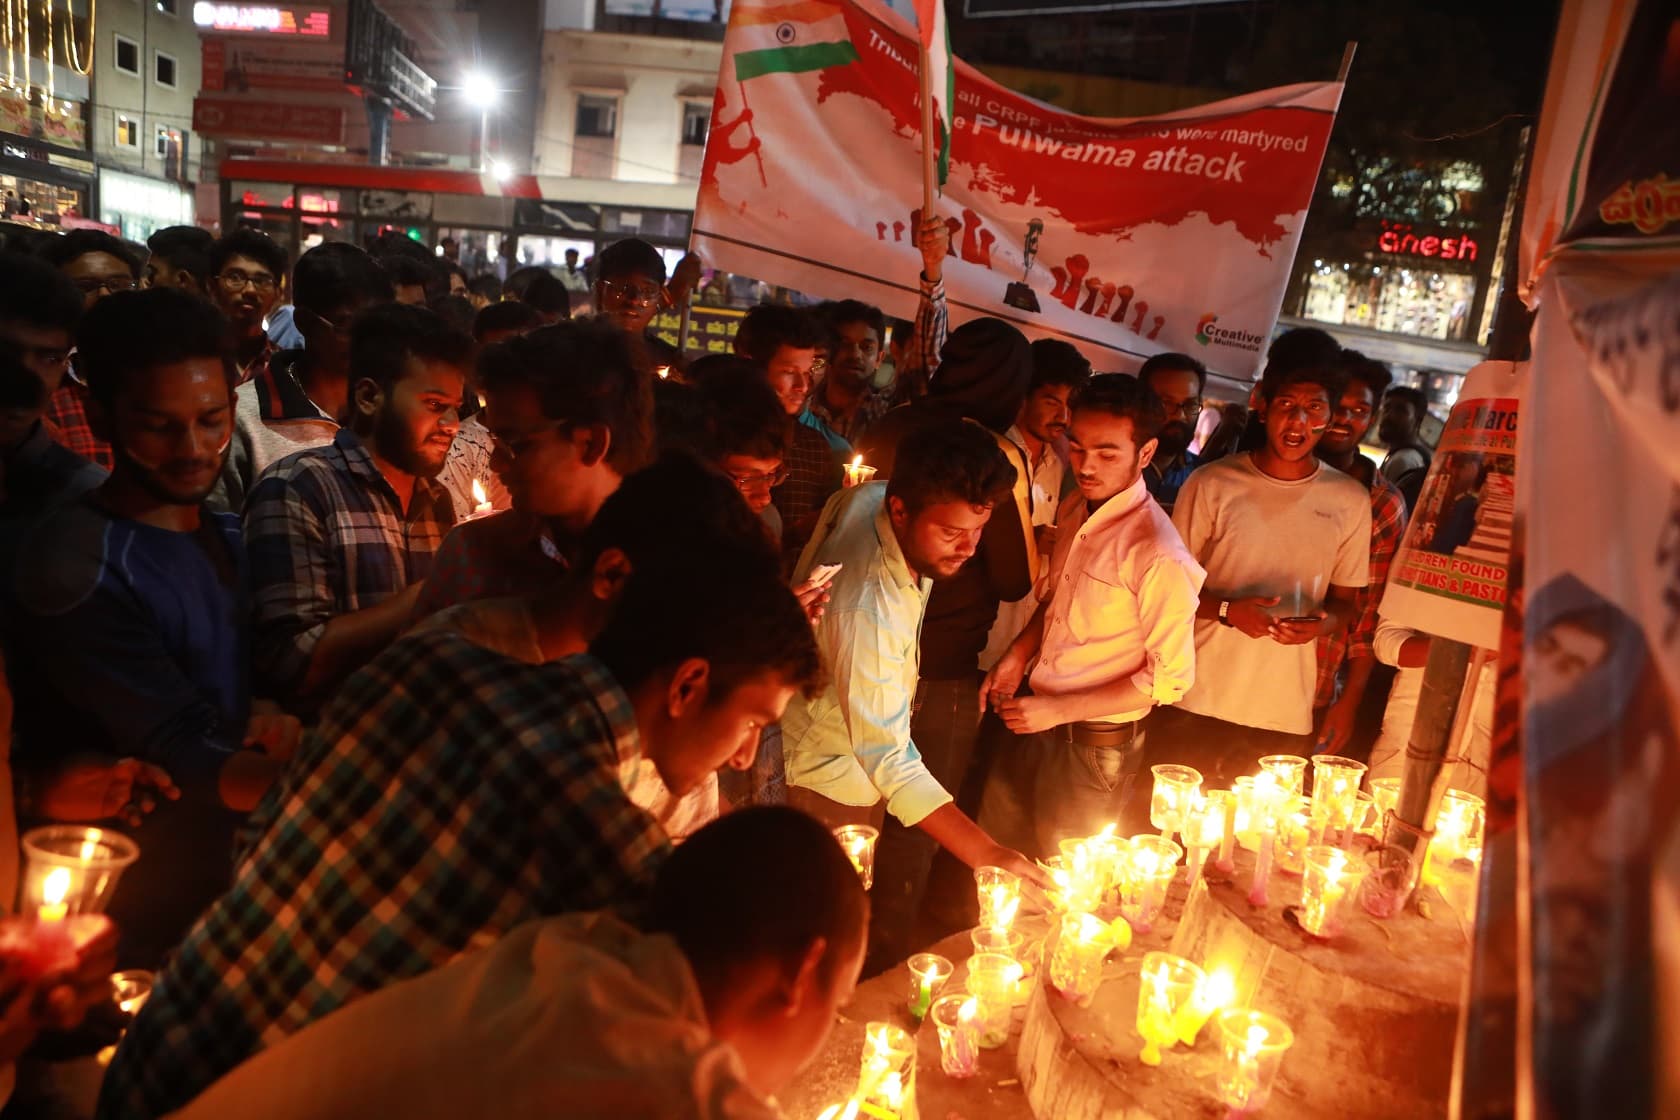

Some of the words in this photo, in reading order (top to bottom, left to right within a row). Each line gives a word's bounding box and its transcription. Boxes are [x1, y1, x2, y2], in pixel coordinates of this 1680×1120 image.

[958, 90, 981, 107] all
[986, 101, 1041, 128] CRPF
[1220, 129, 1308, 152] martyred
[972, 113, 1136, 168] Pulwama
[1143, 146, 1246, 182] attack
[1205, 324, 1262, 344] Creative
[1214, 338, 1260, 352] Multimedia
[1451, 560, 1505, 580] FOUND
[1449, 580, 1459, 592] &
